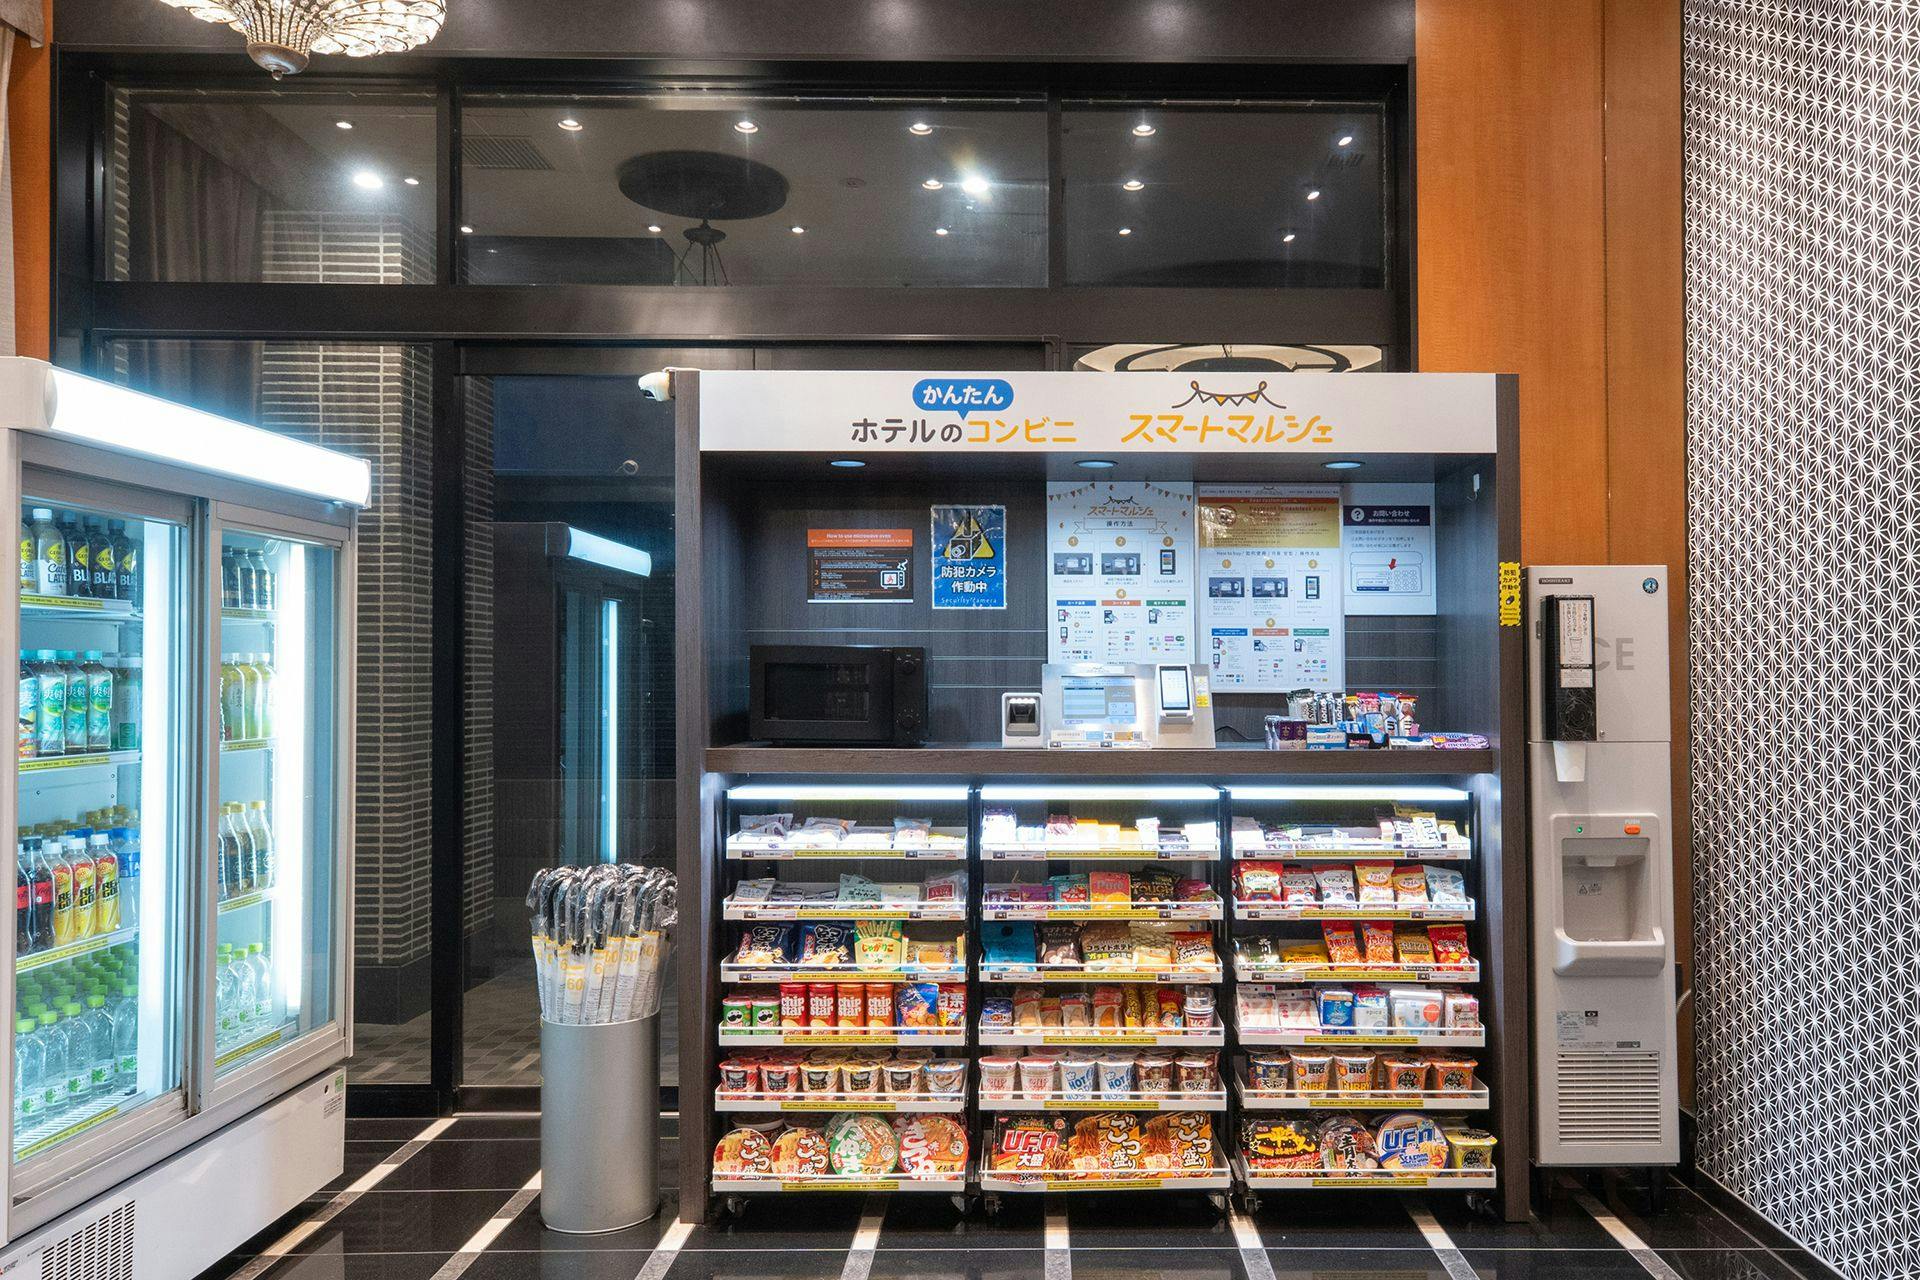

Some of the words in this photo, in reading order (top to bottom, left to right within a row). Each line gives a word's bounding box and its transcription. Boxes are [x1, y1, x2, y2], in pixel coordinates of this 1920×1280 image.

[923, 385, 1004, 405] かんたん
[851, 416, 1075, 444] ホテルのコンビニ
[1121, 414, 1333, 444] スマートマルシェ
[1087, 506, 1154, 516] スマートマルシェ
[941, 566, 997, 578] 防犯カメラ
[951, 581, 988, 593] 作動中
[1594, 637, 1634, 671] CE
[862, 944, 894, 952] じゃがりこ
[567, 978, 584, 991] 60
[1068, 1077, 1087, 1090] HOT
[1108, 1077, 1125, 1090] HOT
[1017, 1153, 1045, 1167] 大盛
